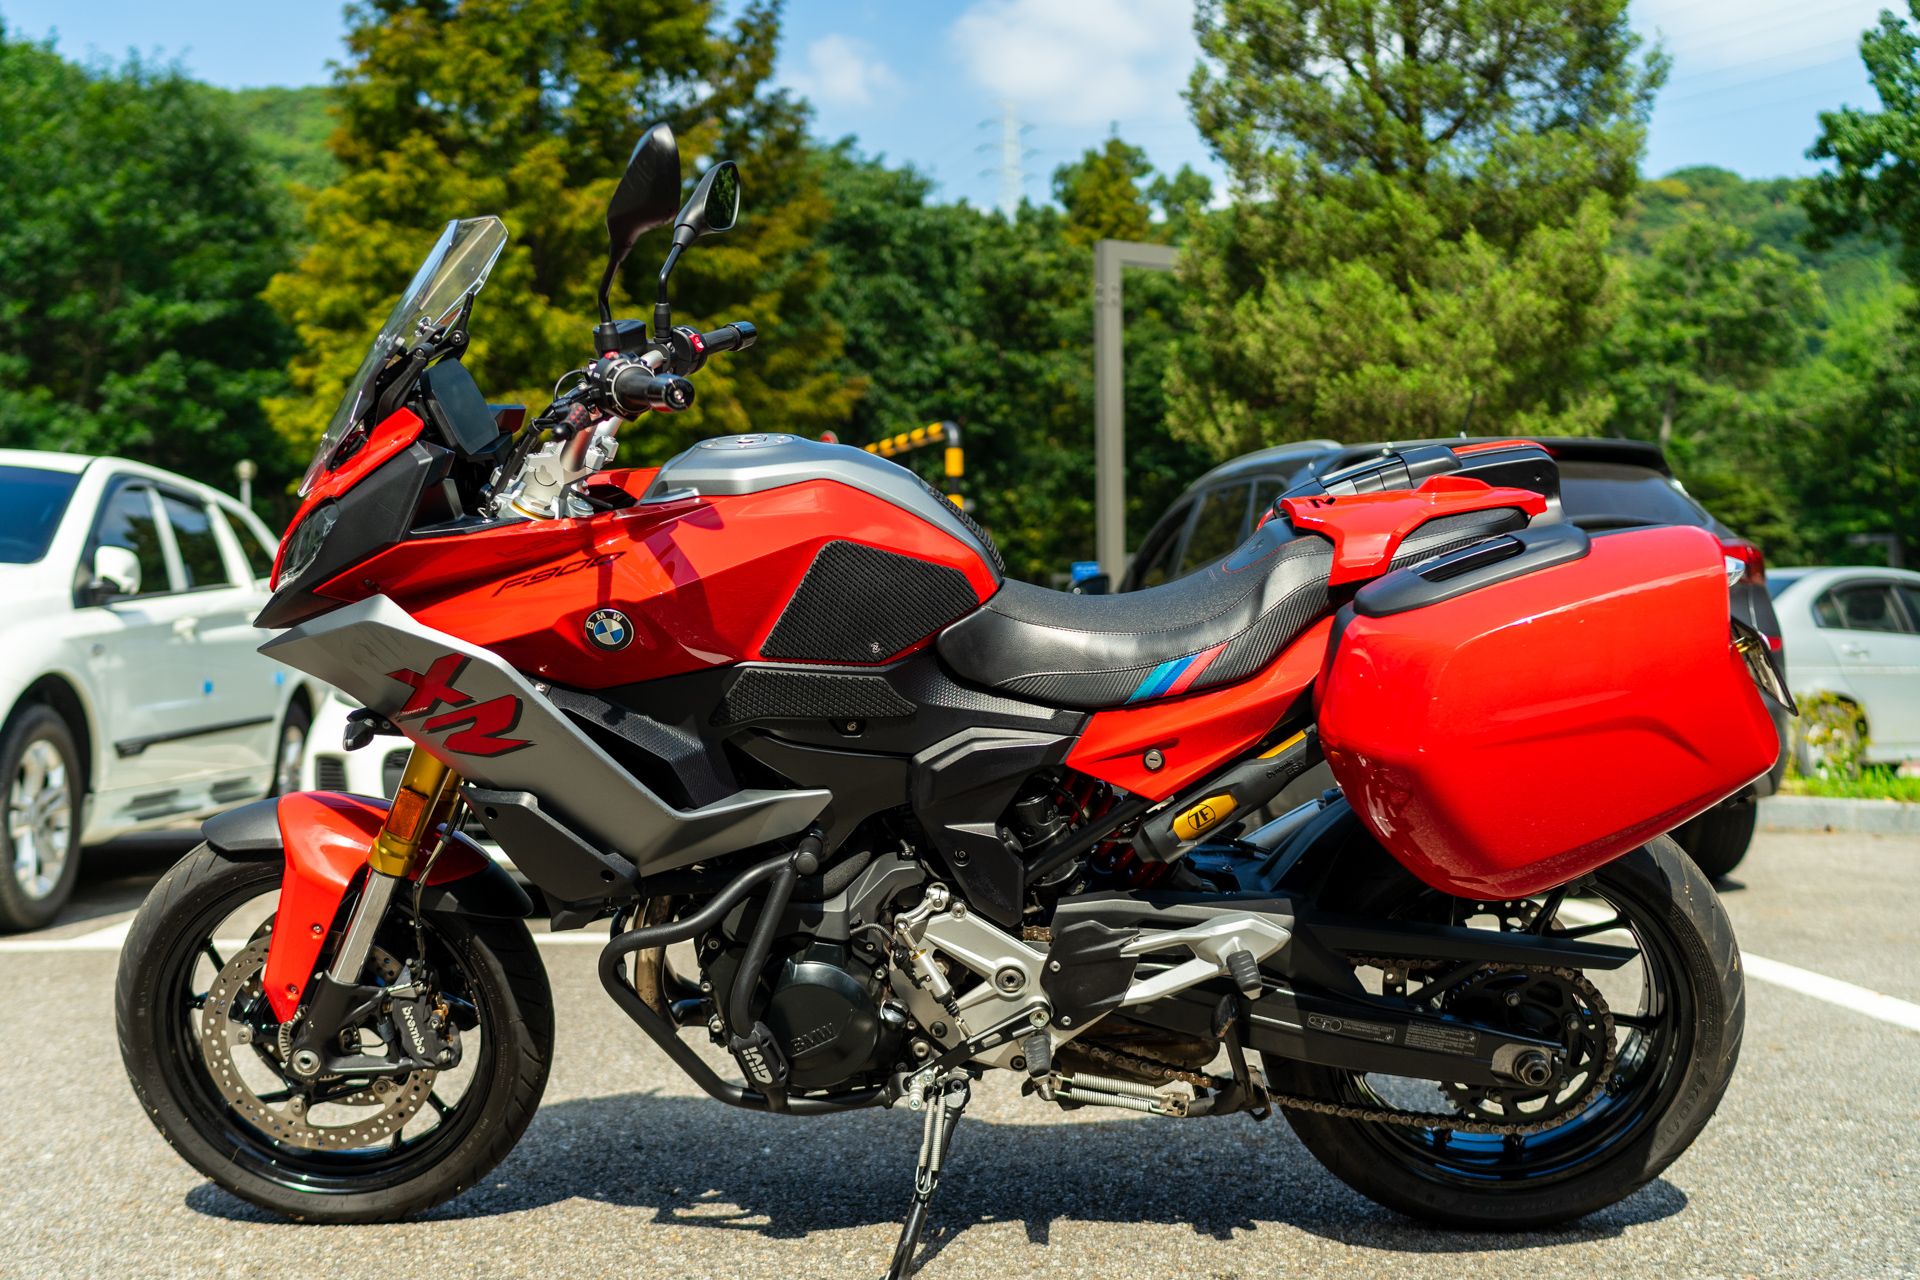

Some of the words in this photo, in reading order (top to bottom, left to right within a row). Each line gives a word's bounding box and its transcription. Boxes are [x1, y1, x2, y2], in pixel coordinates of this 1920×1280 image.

[492, 550, 627, 598] F900
[586, 612, 623, 630] BMW
[1188, 805, 1214, 829] ZF
[402, 1005, 426, 1054] brembo
[742, 1046, 773, 1084] GIVI
